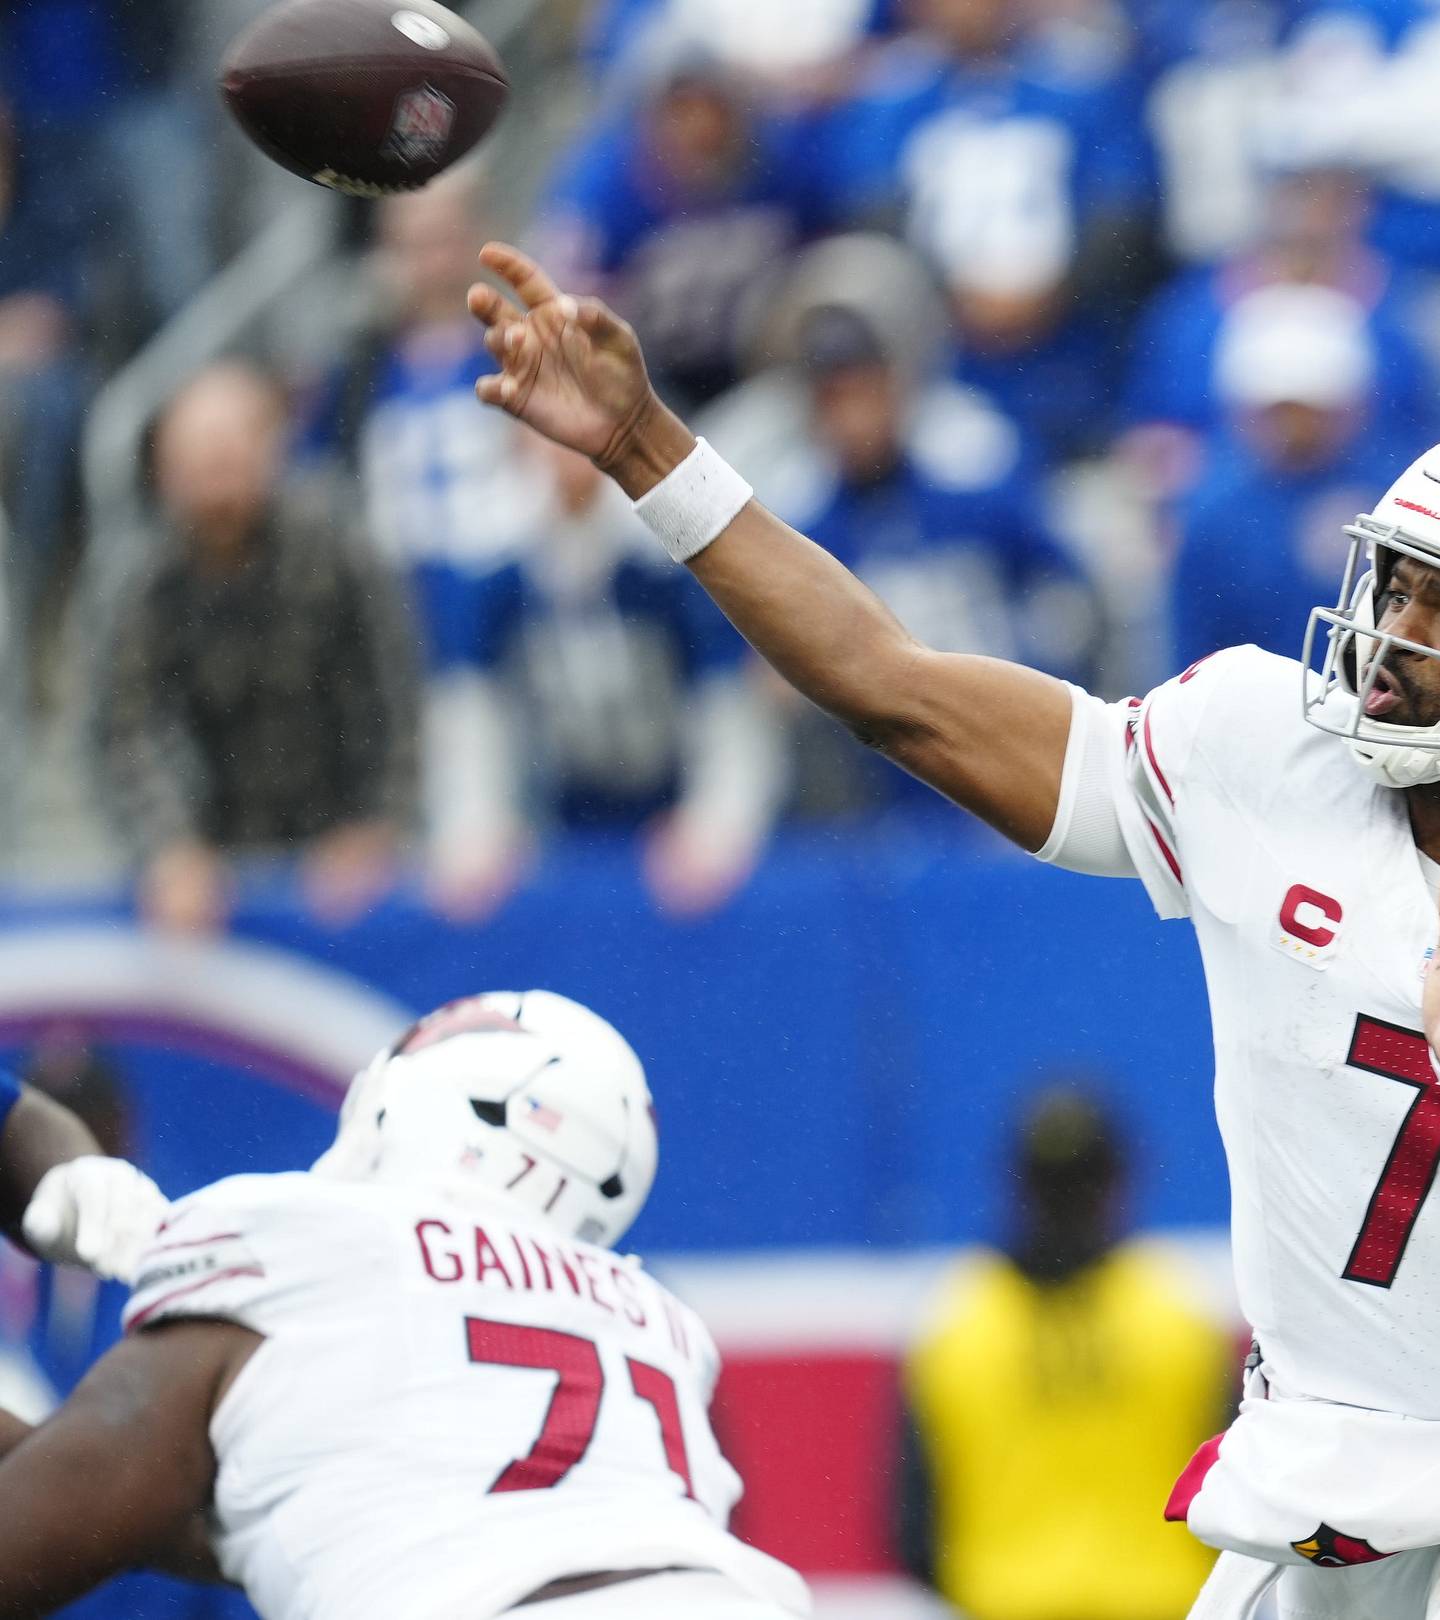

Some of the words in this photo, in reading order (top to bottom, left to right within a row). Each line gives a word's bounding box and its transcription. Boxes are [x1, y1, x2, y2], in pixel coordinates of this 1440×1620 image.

[1279, 883, 1343, 948] C
[505, 1152, 568, 1214] 71
[415, 1218, 648, 1329] GAINES
[464, 1314, 694, 1502] 71
